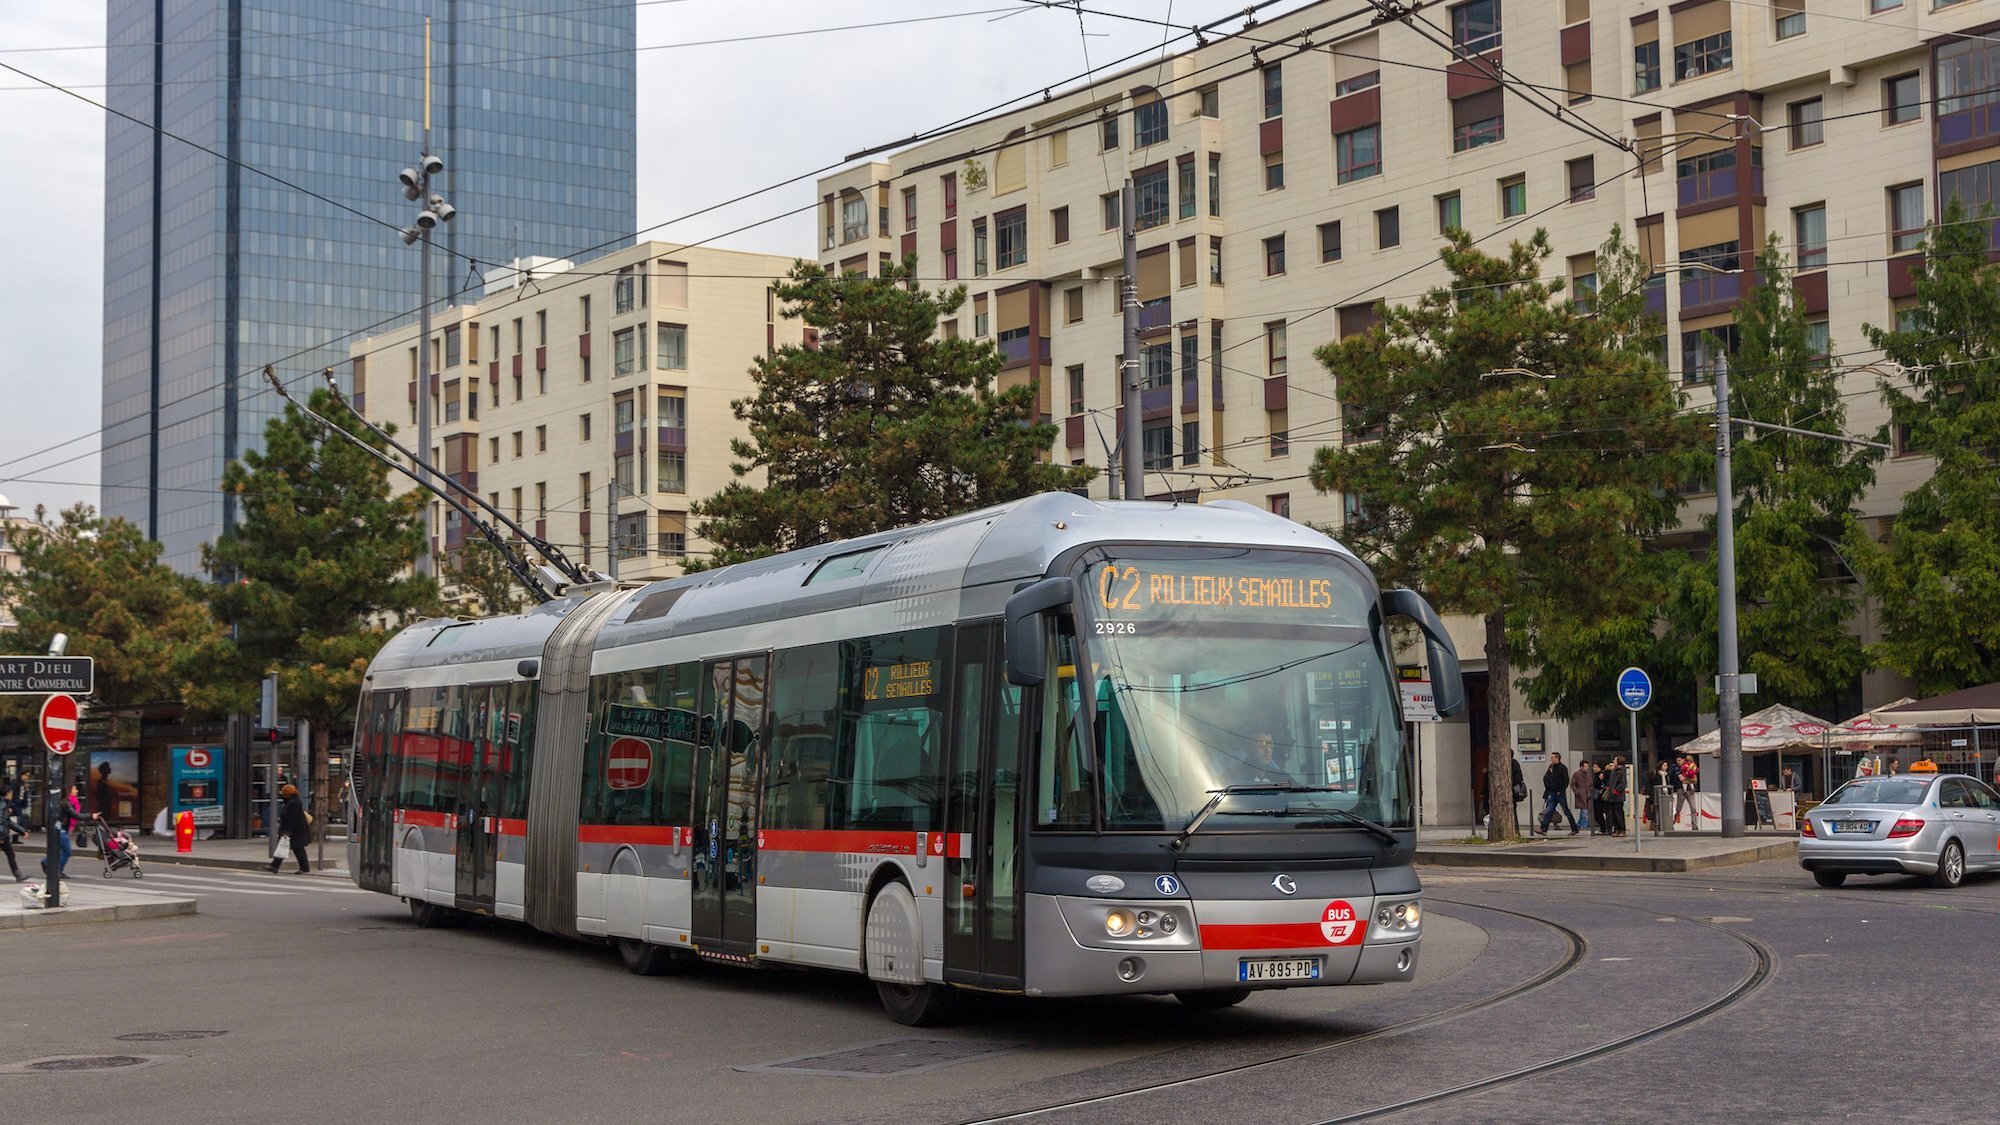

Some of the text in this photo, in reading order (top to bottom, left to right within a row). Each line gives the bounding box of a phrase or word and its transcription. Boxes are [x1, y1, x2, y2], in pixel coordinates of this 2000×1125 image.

[1100, 565, 1332, 610] C2 RILLIEUX SEMAILLES
[1095, 623, 1136, 634] 2926
[34, 661, 72, 674] DIEU
[890, 661, 930, 681] RILLIEUX
[26, 676, 86, 690] COMMERCIAL
[864, 666, 878, 701] C2
[1328, 908, 1350, 920] BUS
[1249, 961, 1311, 979] AV-895-PD
